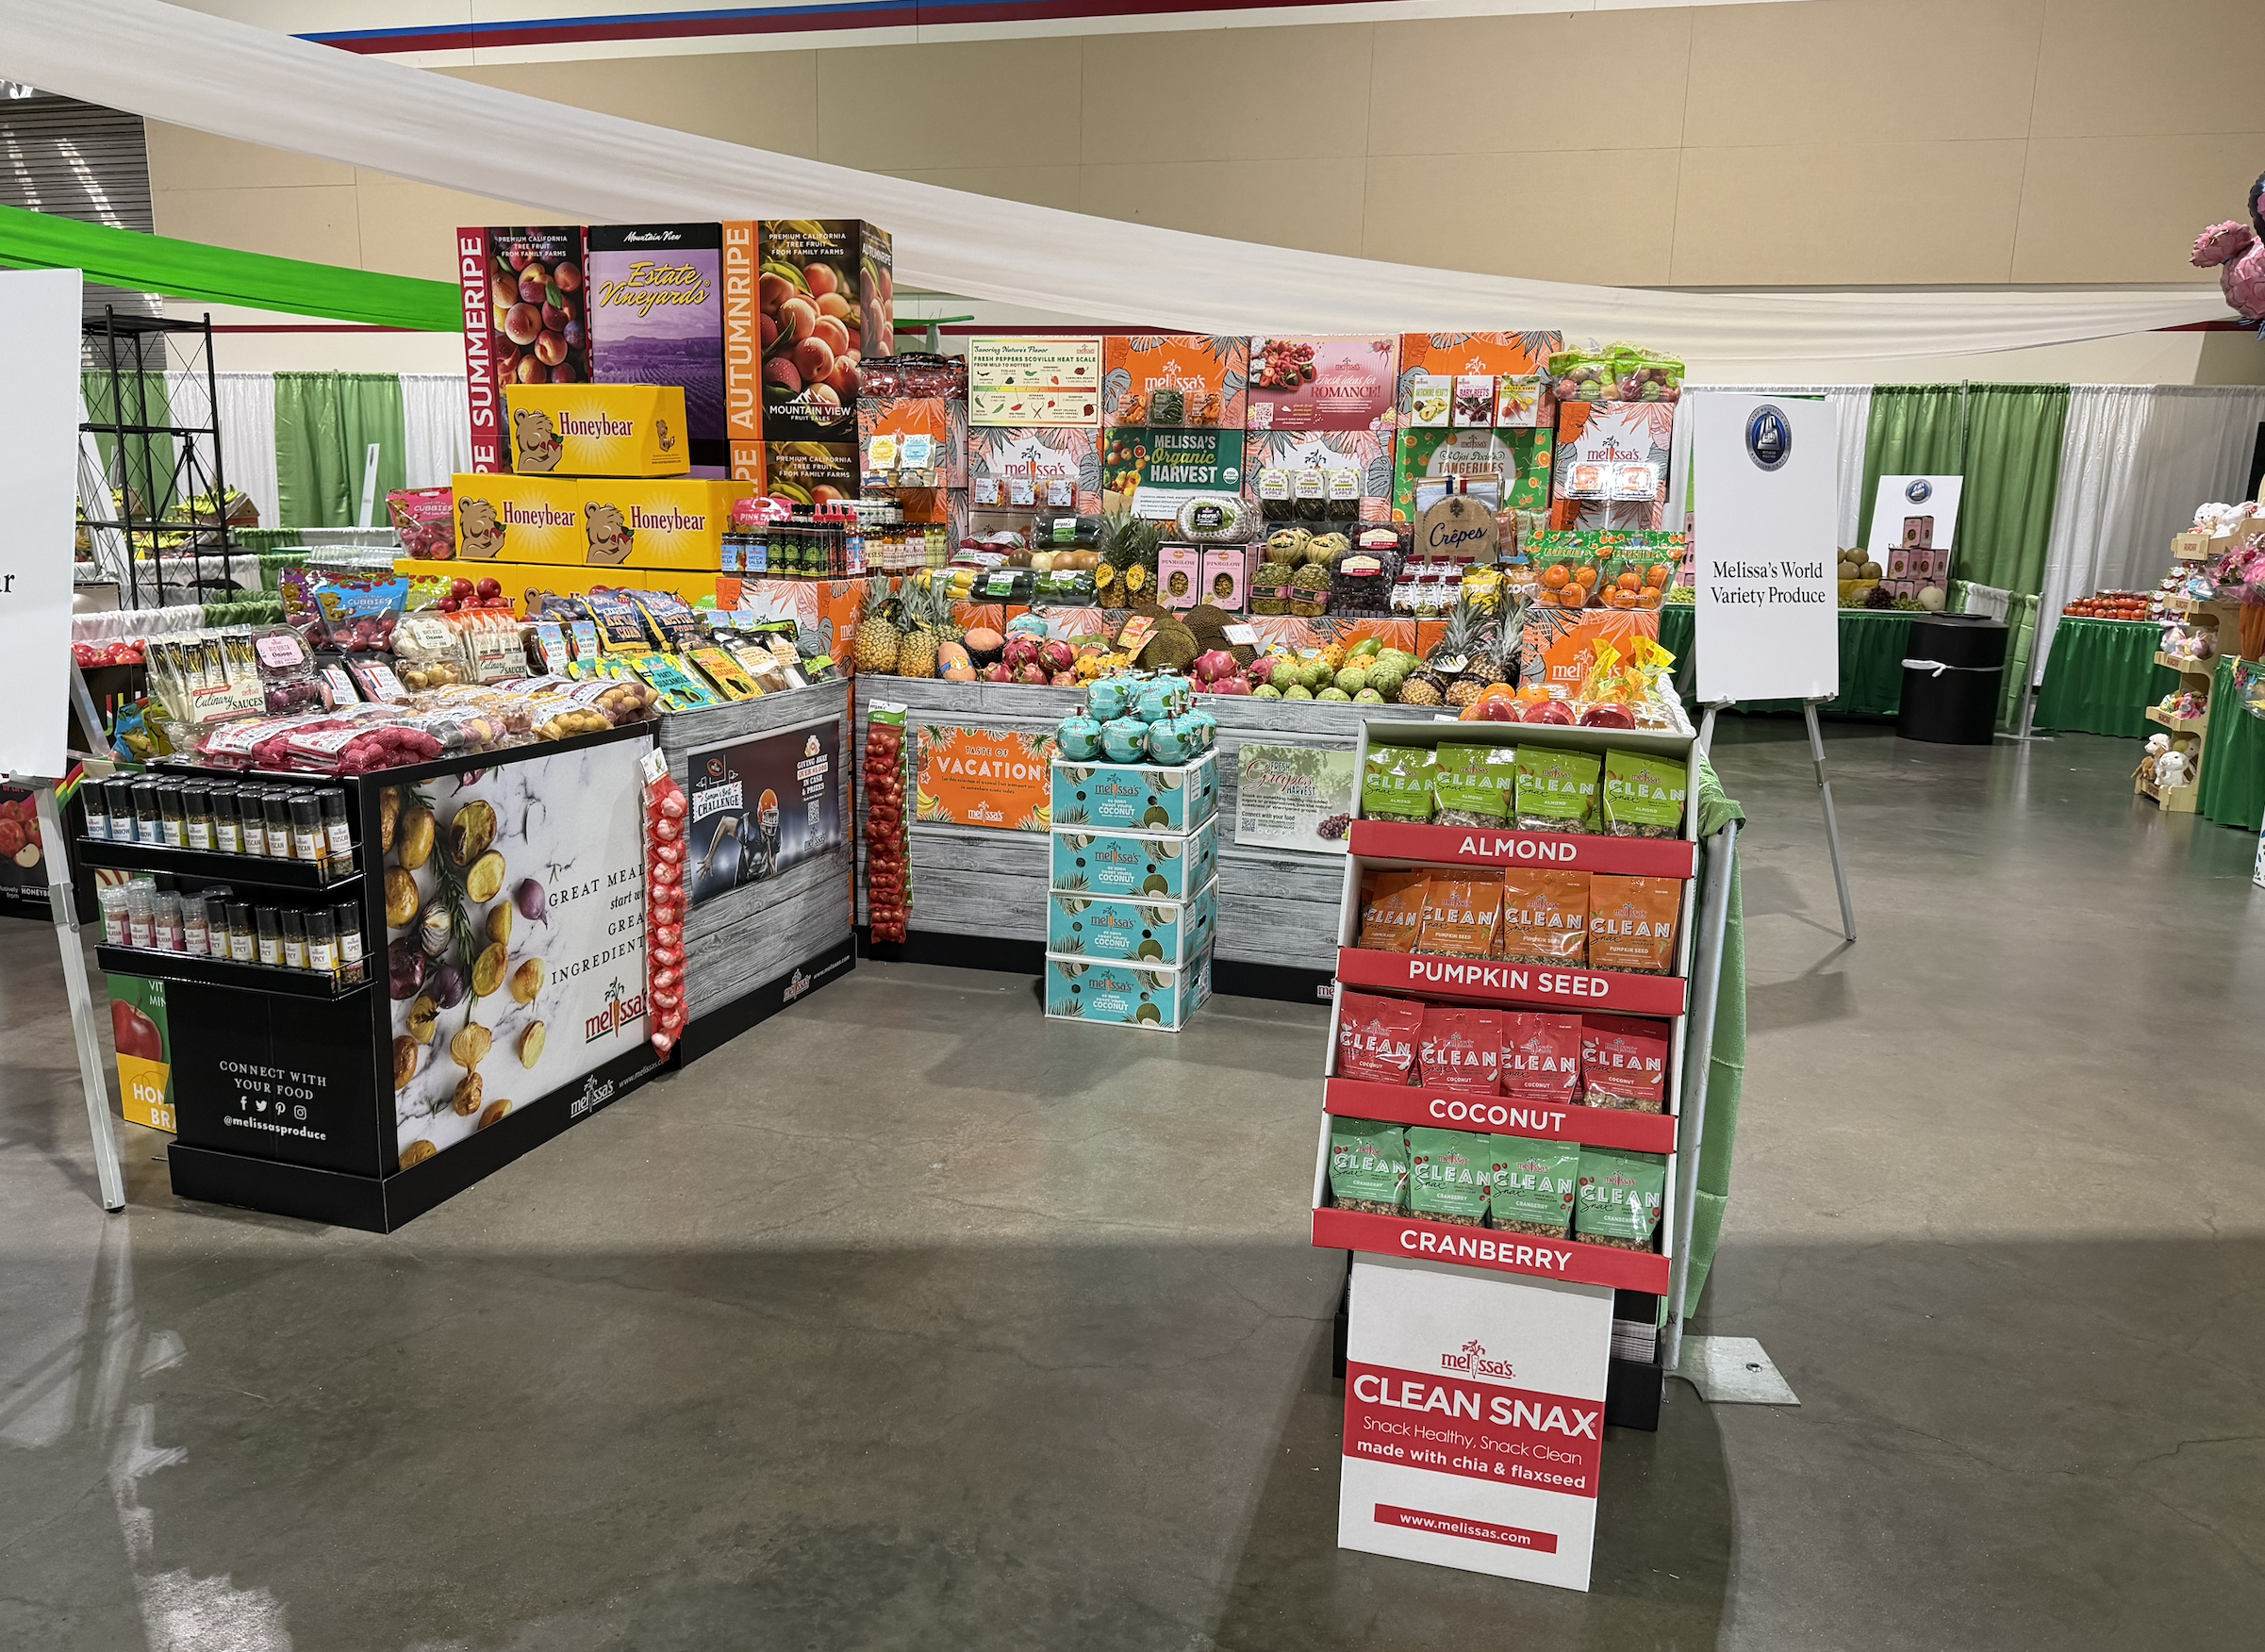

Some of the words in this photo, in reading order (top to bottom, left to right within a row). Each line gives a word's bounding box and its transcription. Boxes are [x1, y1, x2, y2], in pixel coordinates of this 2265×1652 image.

[623, 231, 661, 242] Mountain
[660, 232, 682, 241] View
[628, 261, 702, 288] Estate
[599, 278, 711, 318] Vineyards
[461, 237, 494, 427] SUMMERIPE
[726, 227, 754, 430] AUTUMNRIPE
[974, 346, 1000, 355] Savoring
[1311, 386, 1380, 398] ROMANCE!
[1315, 374, 1339, 386] Fresh
[1342, 375, 1362, 385] ideas
[1361, 375, 1377, 388] for
[769, 405, 830, 416] MOUNTAIN
[832, 406, 851, 416] VIEW
[558, 411, 634, 438] Honeybear
[1154, 435, 1215, 450] MELISSA'S
[1151, 448, 1215, 469] Organic
[1453, 451, 1469, 460] Ojai
[1587, 448, 1641, 461] melissa's
[1150, 465, 1217, 483] HARVEST
[1438, 462, 1503, 473] TANGERINES
[630, 505, 706, 535] Honeybear
[1430, 522, 1488, 548] Crêpes
[1712, 561, 1778, 580] Melissa's
[1780, 561, 1823, 579] World
[1711, 586, 1765, 607] Variety
[1768, 586, 1826, 603] Produce
[654, 675, 691, 687] GUACAMOLE
[195, 694, 234, 711] Culinary
[232, 696, 264, 711] SAUCES
[966, 746, 992, 756] TASTE
[996, 749, 1009, 757] OF
[797, 759, 816, 769] GIVING
[936, 756, 1041, 781] VACATION
[1242, 759, 1314, 791] Grapes
[1271, 762, 1290, 771] FRESH
[802, 778, 809, 786] IN
[809, 774, 823, 785] CASH
[806, 783, 825, 795] PRIZES
[1095, 784, 1141, 797] melissa's
[1287, 785, 1315, 796] HARVEST
[1609, 779, 1685, 801] CLEAN
[699, 795, 739, 817] CHALLENGE
[968, 809, 1004, 821] melissa's
[1099, 807, 1135, 816] COCONUT
[333, 834, 349, 844] TUSCAN
[1458, 836, 1578, 863] ALMOND
[549, 879, 600, 908] GREAT
[607, 864, 645, 888] MEAL
[610, 889, 632, 910] start
[608, 913, 645, 936] GREA
[1590, 918, 1671, 938] CLEAN
[552, 934, 646, 985] INGREDIENT
[813, 954, 850, 981] www.melissas.com
[1409, 960, 1529, 991] PUMPKIN
[1538, 973, 1610, 998] SEED
[586, 988, 648, 1039] melissa's
[1582, 1048, 1662, 1071] CLEAN
[219, 1060, 285, 1080] CONNECT
[289, 1071, 327, 1086] WITH
[1608, 1076, 1634, 1084] COCONUT
[234, 1078, 272, 1094] YOUR
[276, 1085, 314, 1100] FOOD
[570, 1079, 616, 1119] melissa's
[1429, 1099, 1566, 1132] COCONUT
[223, 1115, 327, 1141] @melissasproduce
[1415, 1164, 1490, 1186] CLEAN
[1436, 1193, 1467, 1201] CRANBERRY
[1399, 1230, 1572, 1272] CRANBERRY
[1442, 1352, 1516, 1380] melissa's
[1353, 1374, 1481, 1422] CLEAN
[1488, 1396, 1600, 1441] SNAX
[1363, 1415, 1412, 1438] Snack
[1414, 1425, 1478, 1451] Healthy,
[1480, 1435, 1529, 1457] Snack
[1533, 1445, 1583, 1466] Clean
[1357, 1438, 1405, 1460] made
[1410, 1446, 1447, 1466] with
[1452, 1454, 1489, 1474] chia
[1493, 1462, 1506, 1476] &
[1511, 1463, 1586, 1489] flaxseed
[1400, 1512, 1531, 1545] www.melissas.com
